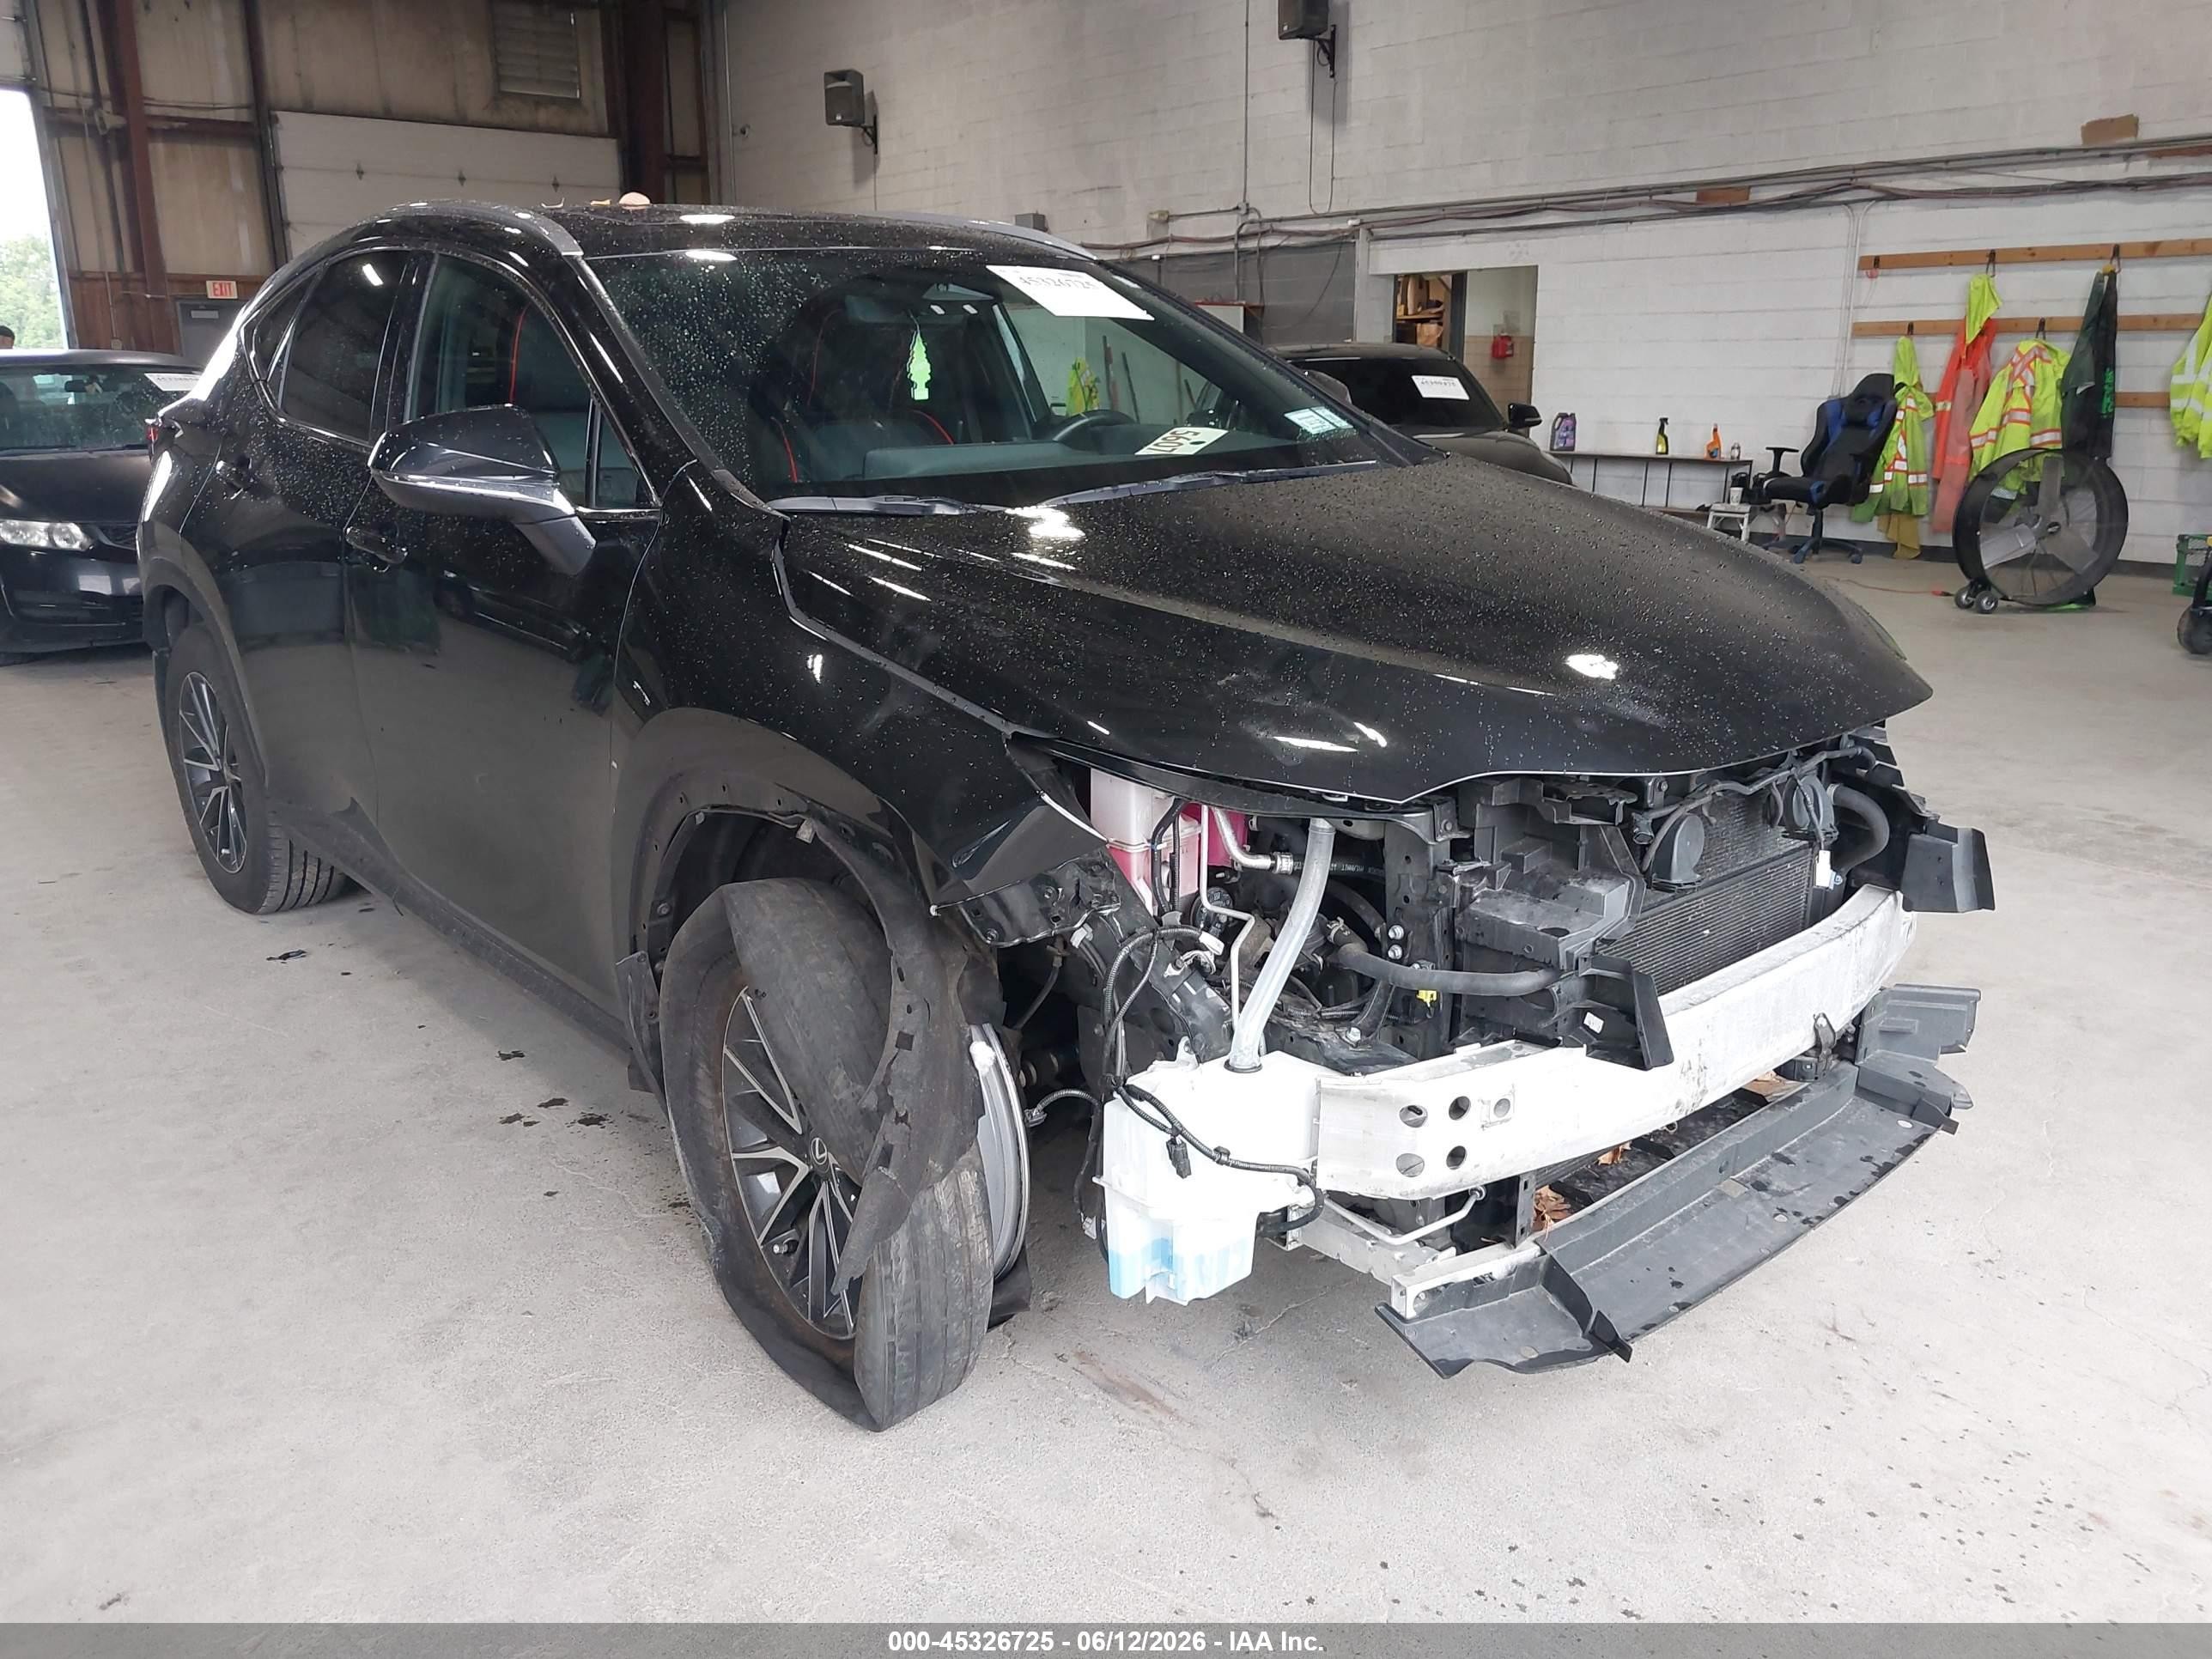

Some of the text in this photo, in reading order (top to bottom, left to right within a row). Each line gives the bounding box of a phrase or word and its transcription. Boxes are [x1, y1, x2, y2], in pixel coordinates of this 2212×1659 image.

[1018, 276, 1097, 289] 45326725
[212, 283, 233, 296] EXIT
[1147, 430, 1201, 453] 5607
